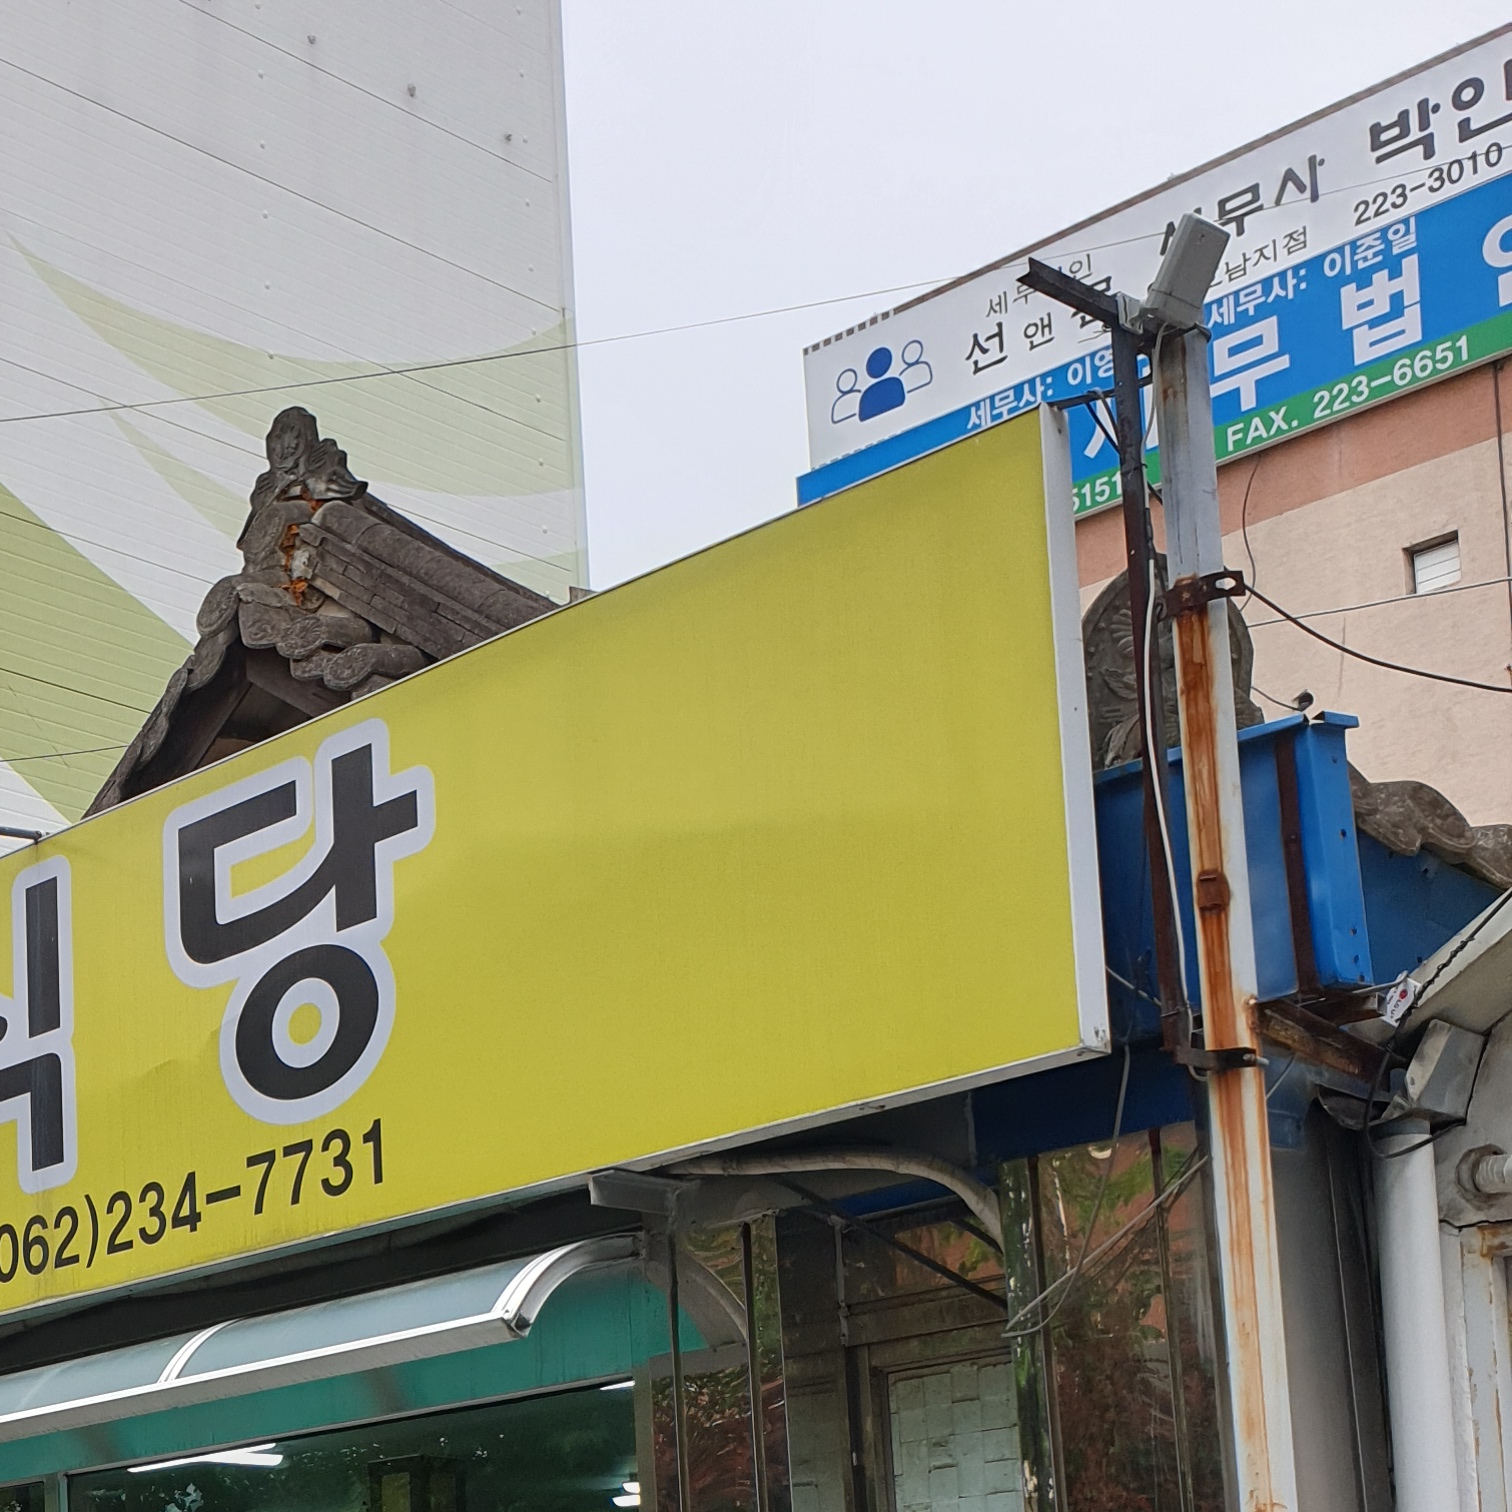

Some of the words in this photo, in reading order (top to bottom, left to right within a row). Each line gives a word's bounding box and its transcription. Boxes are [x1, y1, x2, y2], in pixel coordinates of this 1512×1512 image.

[1160, 153, 1325, 256] 무사
[1354, 142, 1503, 227] 223-3010
[1208, 268, 1307, 327] 세무사:
[1324, 216, 1416, 277] 이준일
[1210, 226, 1308, 287] 남지점
[966, 376, 1053, 429] 세무사:
[1227, 406, 1298, 452] FAX.
[1313, 335, 1468, 419] 223-6651
